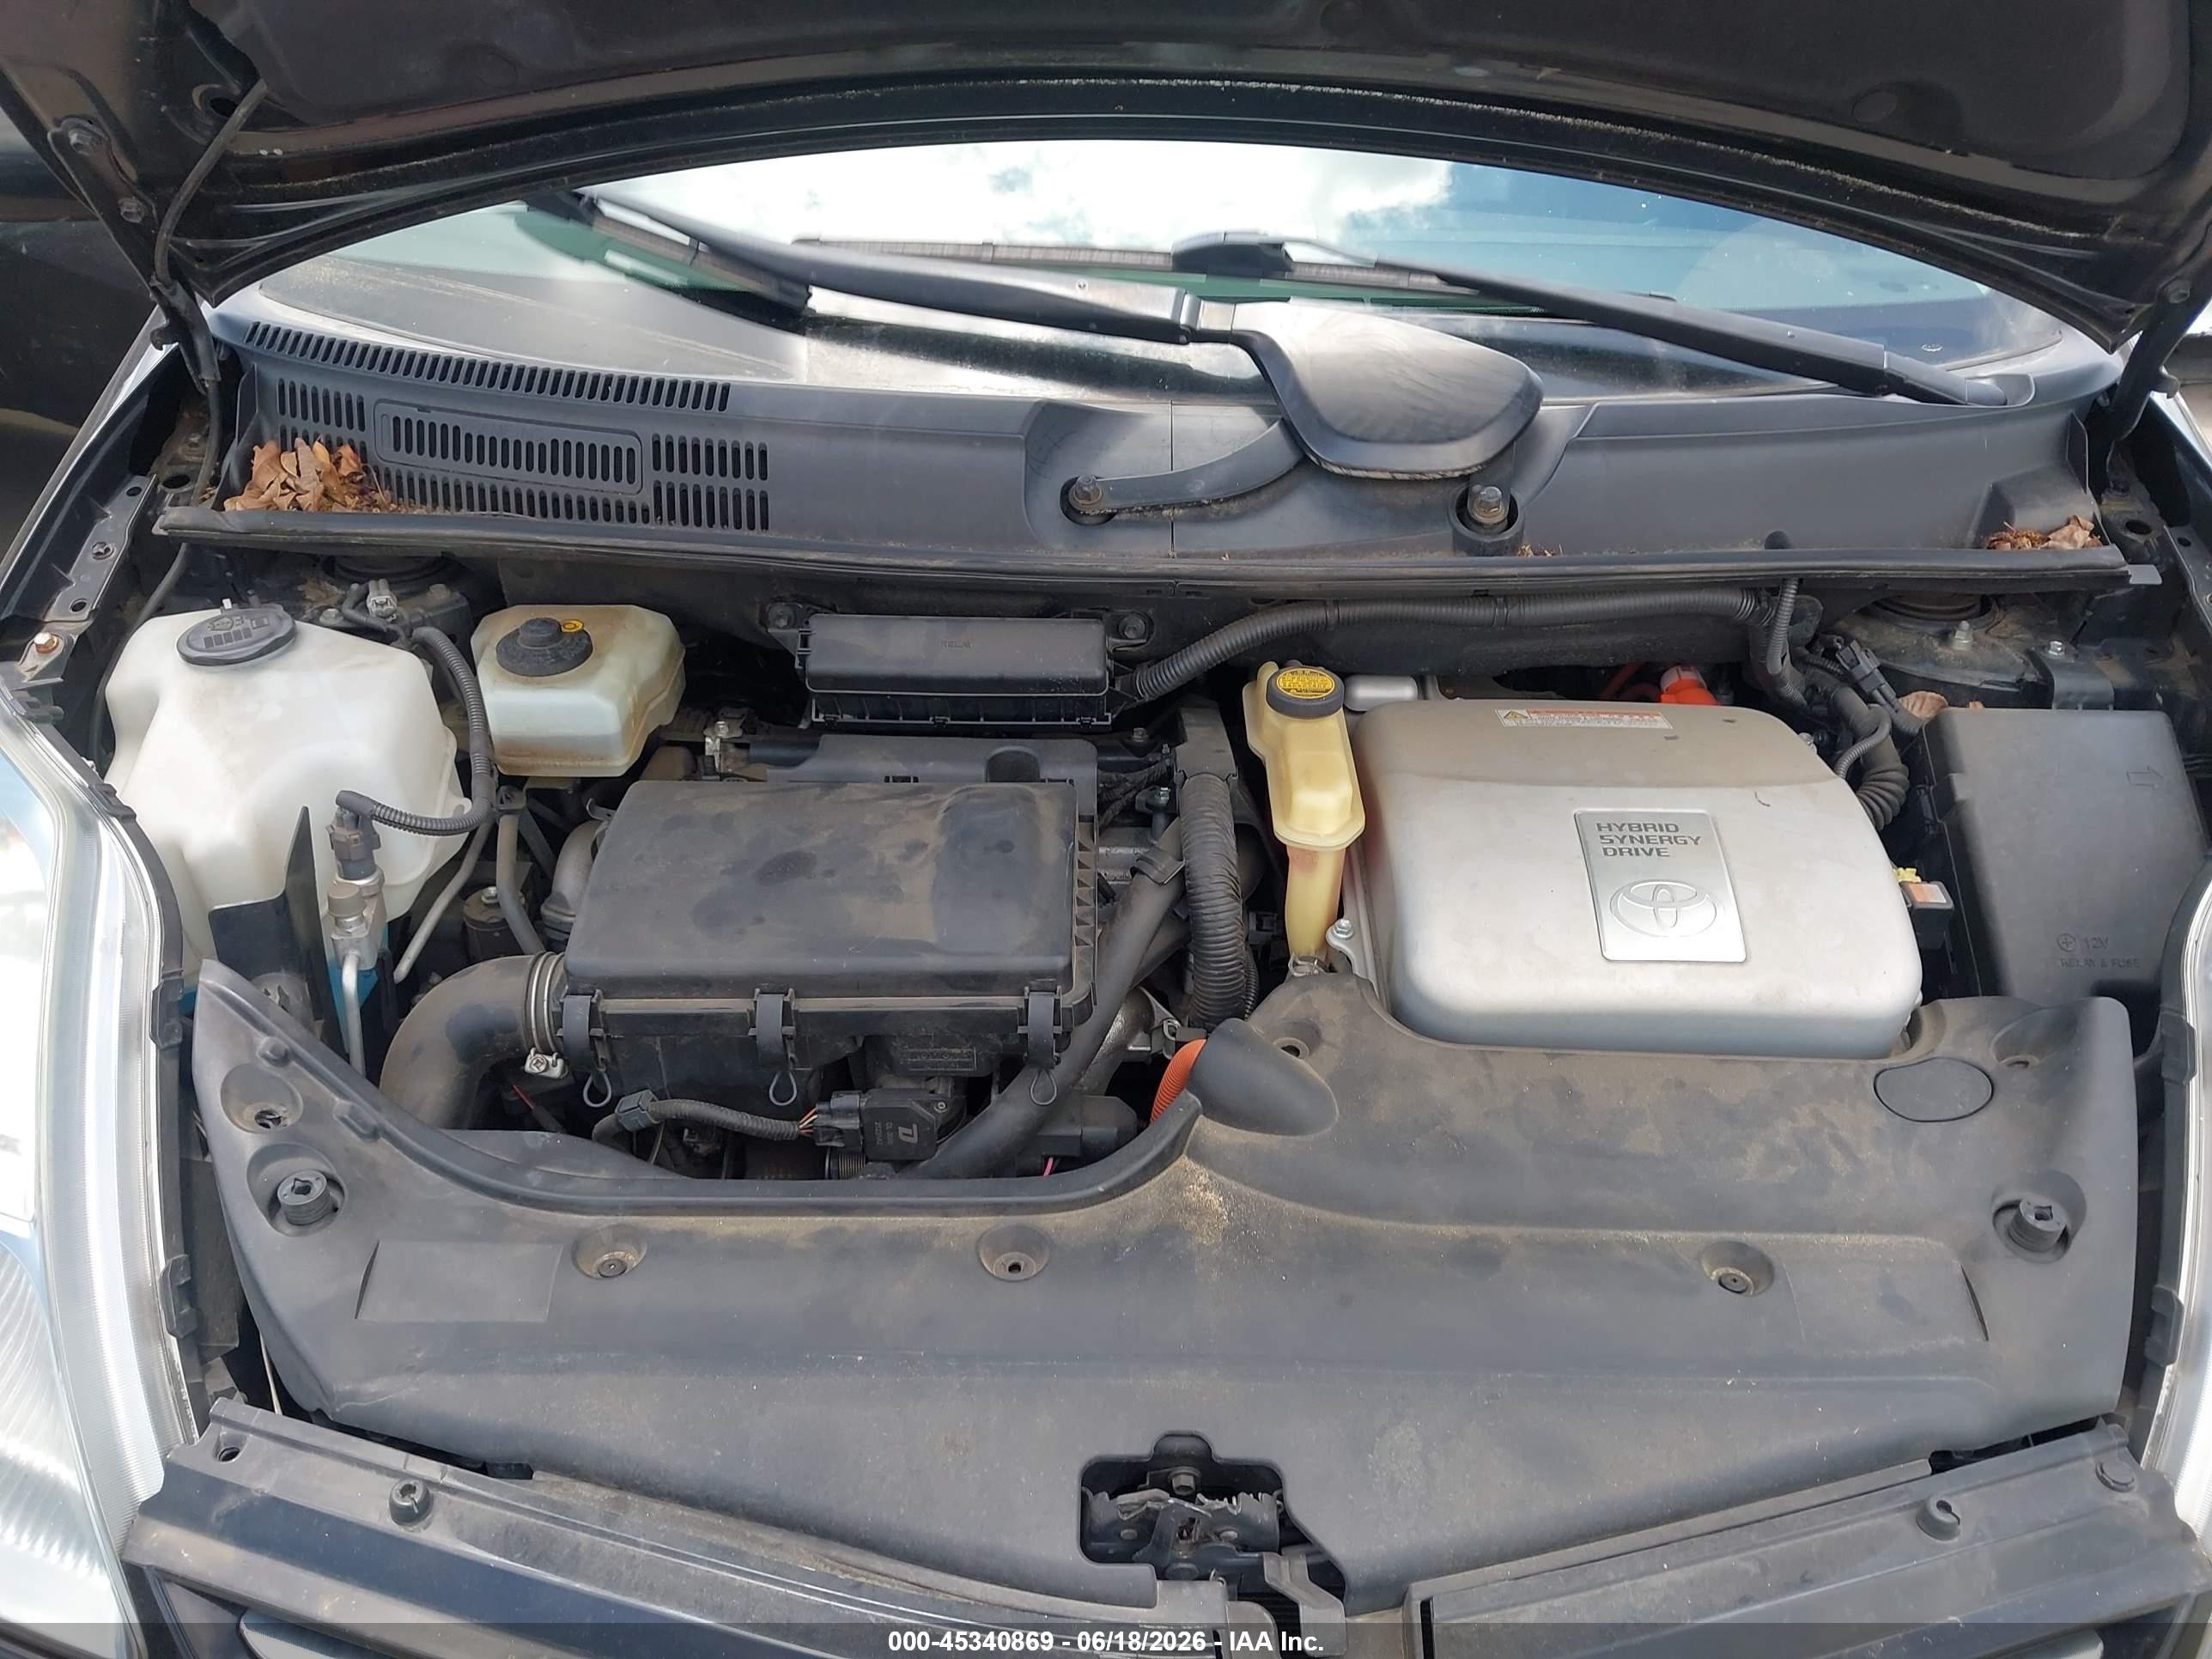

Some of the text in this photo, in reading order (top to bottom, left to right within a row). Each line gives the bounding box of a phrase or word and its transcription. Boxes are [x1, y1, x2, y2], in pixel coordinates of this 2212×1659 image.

[1596, 822, 1680, 833] HYBRID
[1599, 834, 1701, 846] SYNERGY
[1602, 847, 1670, 858] DRIVE
[2082, 936, 2109, 949] 12V
